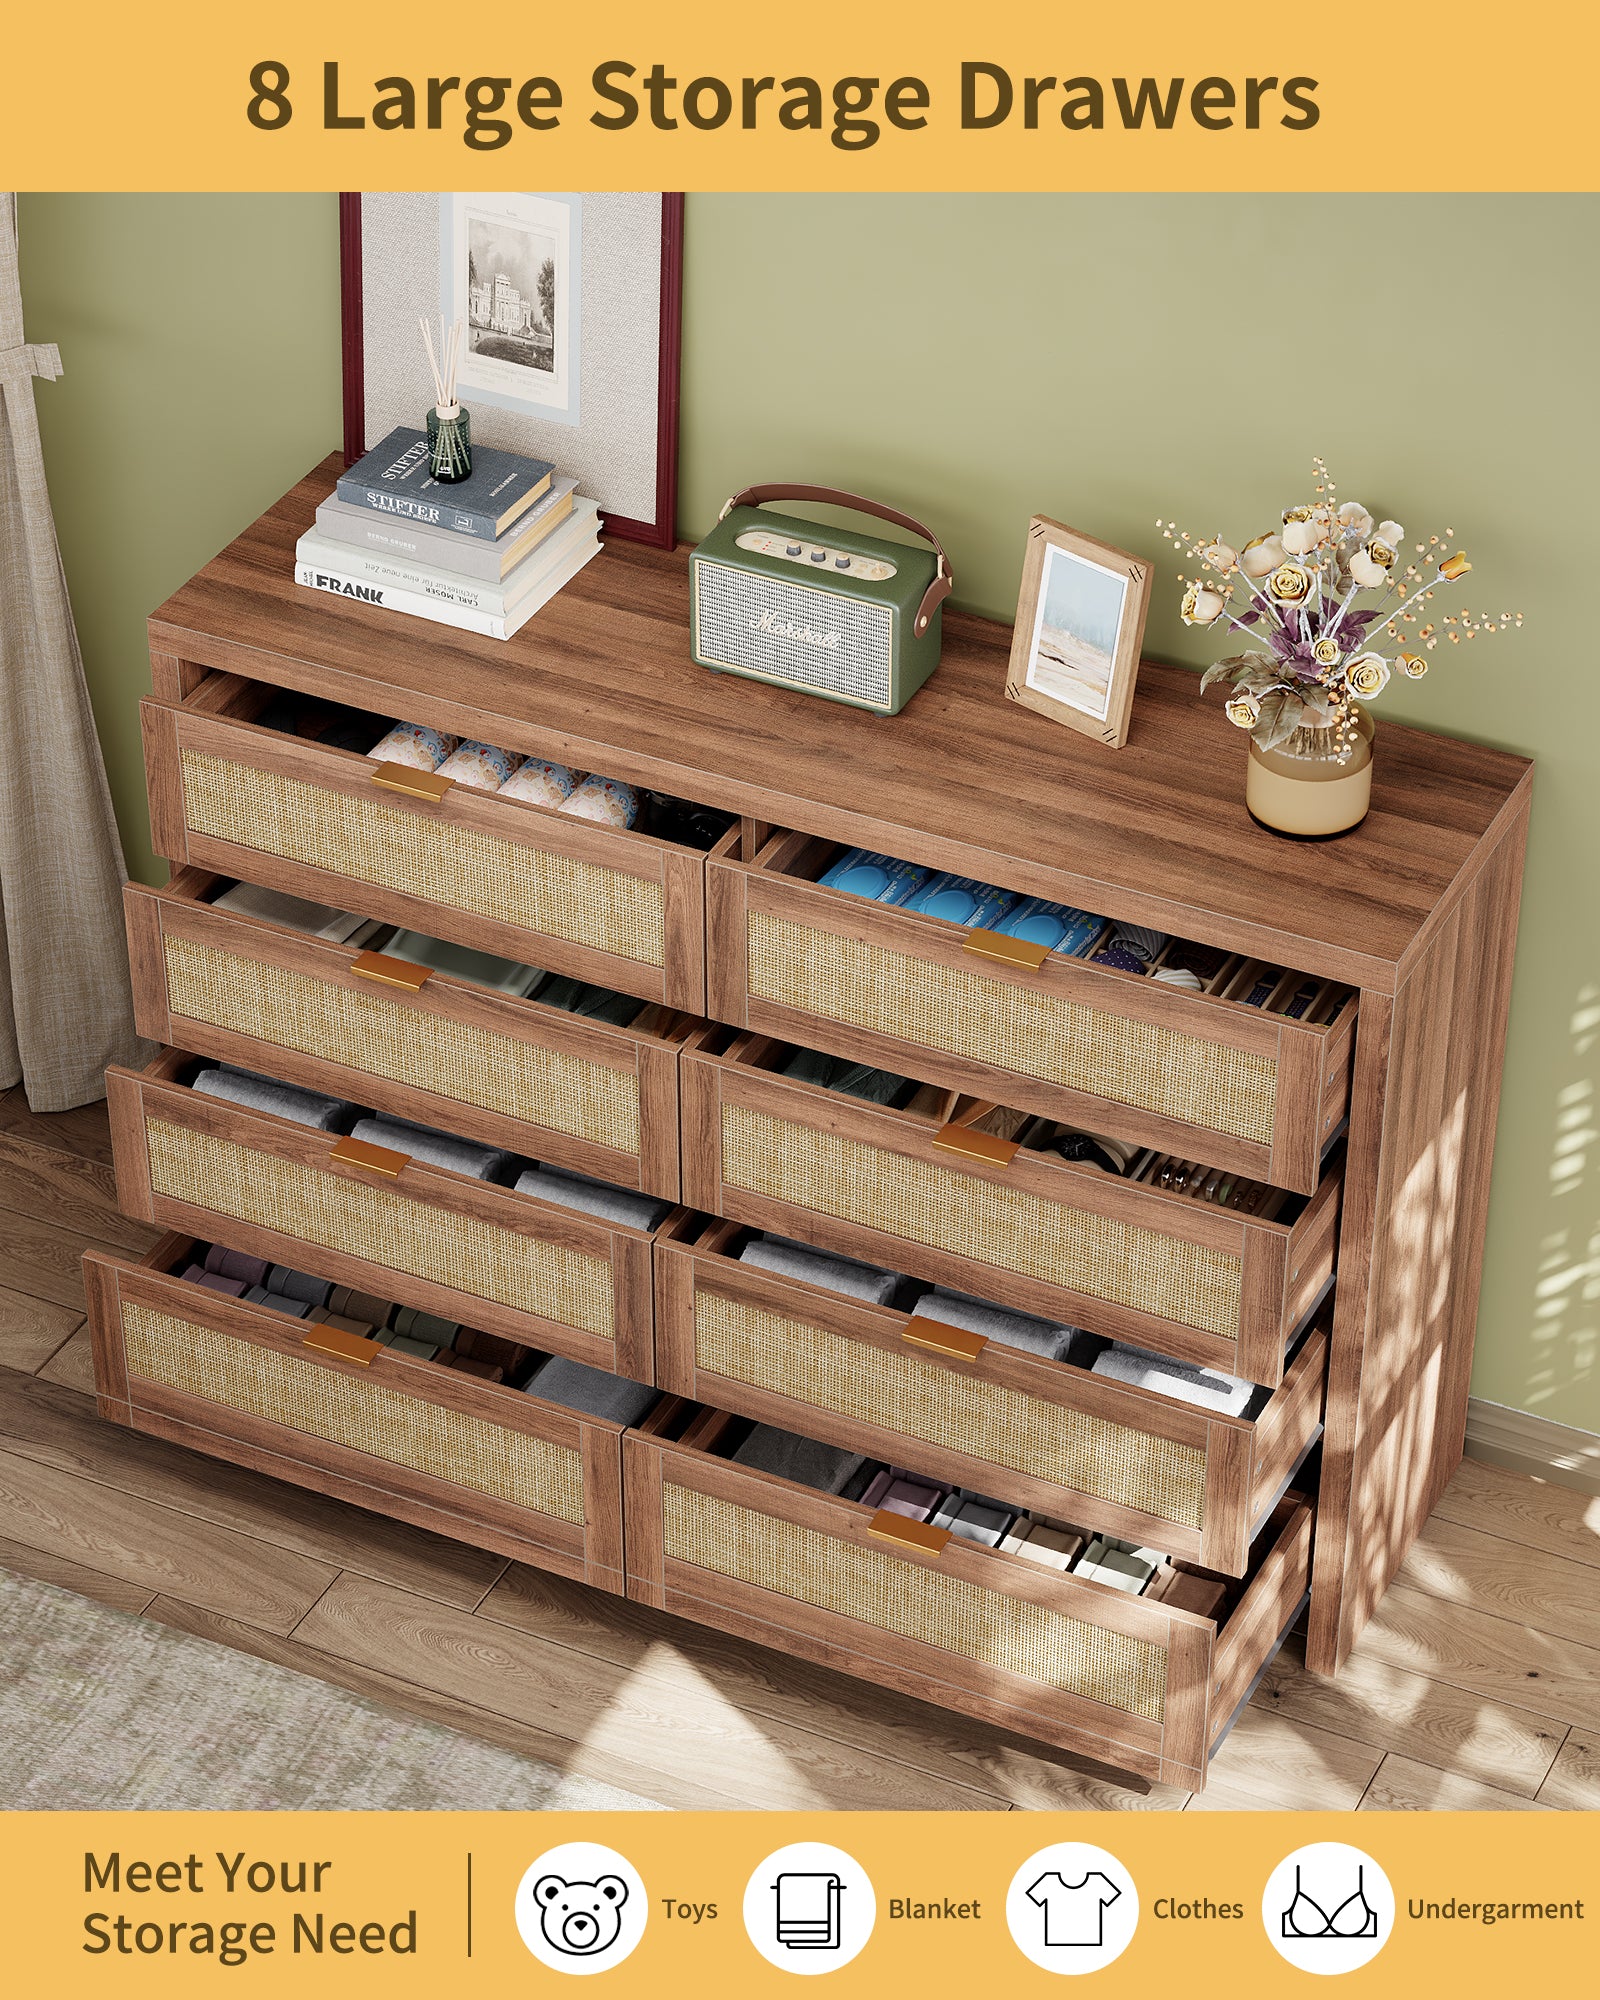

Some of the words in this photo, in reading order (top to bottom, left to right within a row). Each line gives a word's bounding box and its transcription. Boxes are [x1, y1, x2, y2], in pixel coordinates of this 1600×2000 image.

[381, 441, 428, 480] STIFTER
[366, 491, 440, 521] STIFTER
[364, 562, 380, 573] Zeit
[382, 567, 400, 577] neue
[402, 572, 420, 582] eine
[316, 574, 384, 605] FRANK
[425, 586, 454, 600] MOSER
[435, 582, 479, 600] Architektur
[457, 595, 479, 607] CARL
[750, 610, 841, 648] Marshall
